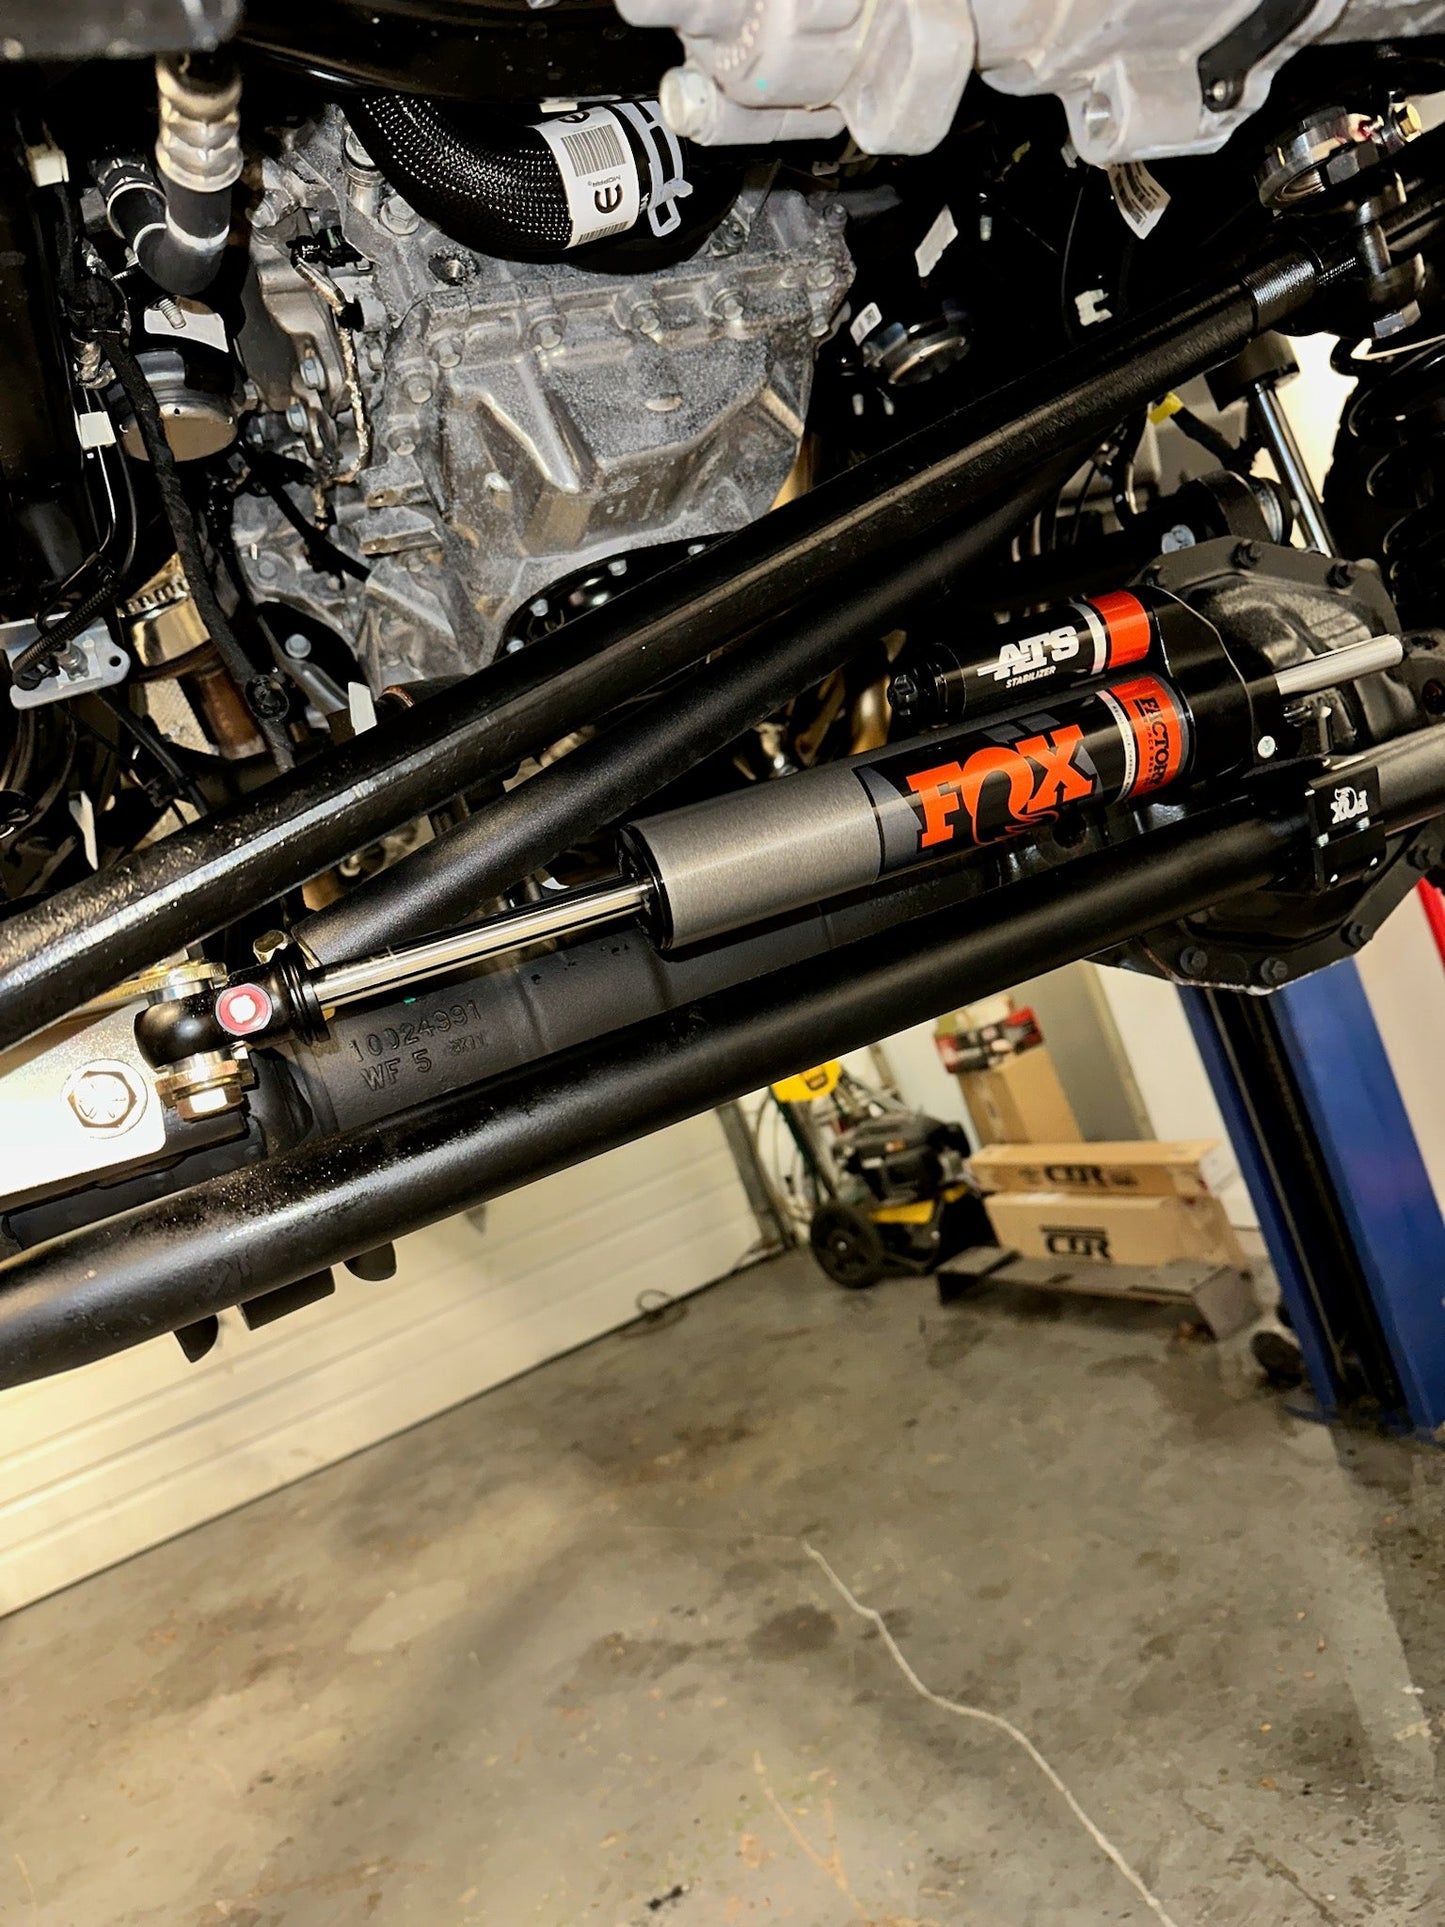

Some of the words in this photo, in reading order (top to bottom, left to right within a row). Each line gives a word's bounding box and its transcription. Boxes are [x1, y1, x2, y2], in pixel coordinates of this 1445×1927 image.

[977, 625, 1079, 681] ATS
[1005, 665, 1056, 689] STABILIZER
[1139, 696, 1170, 785] FACTORY
[906, 724, 1094, 846] FOX
[1330, 786, 1369, 825] FOX
[361, 1057, 401, 1092] WF
[411, 1048, 432, 1074] 5
